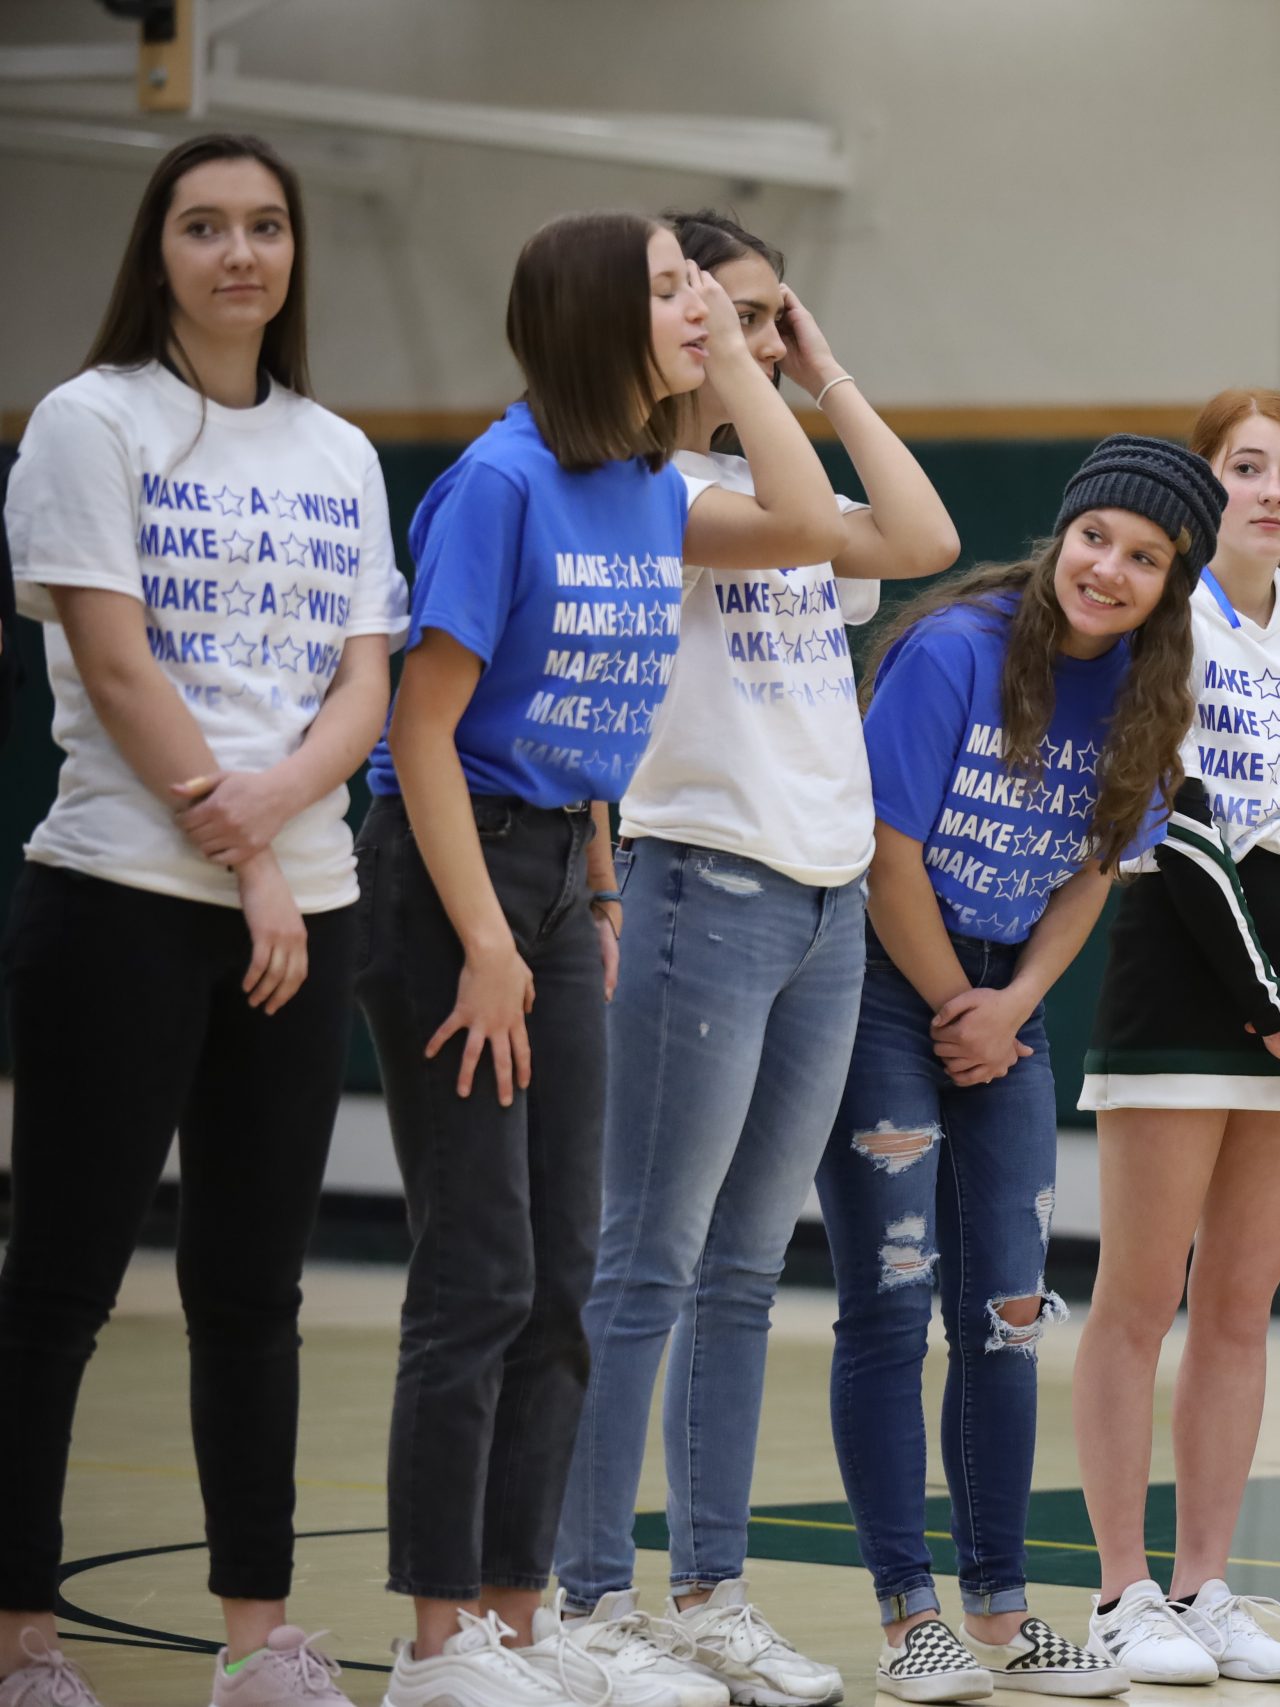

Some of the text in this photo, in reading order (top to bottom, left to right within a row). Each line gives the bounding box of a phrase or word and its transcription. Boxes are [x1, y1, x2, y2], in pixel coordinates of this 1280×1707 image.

[143, 473, 360, 530] MAKE A WISH
[141, 524, 360, 578] MAKE A WISH
[556, 553, 613, 587] MAKE
[629, 555, 643, 587] A
[141, 575, 218, 613] MAKE
[260, 582, 277, 615] A
[552, 602, 616, 636] MAKE
[636, 603, 647, 636] A
[146, 626, 219, 664] MAKE
[726, 629, 780, 663] AKE
[794, 634, 804, 664] A
[623, 652, 638, 684] A
[525, 691, 592, 729] MAKE
[613, 702, 629, 733] A
[1198, 703, 1260, 737] MAKE
[610, 754, 621, 780] A
[1056, 740, 1073, 770] A
[1198, 745, 1264, 782] MAKE
[952, 766, 1065, 814] MAKE A
[937, 807, 1015, 854] MAKE
[1031, 830, 1052, 856] A
[925, 846, 998, 894] MAKE
[1015, 869, 1030, 898] A
[1002, 916, 1019, 937] A
